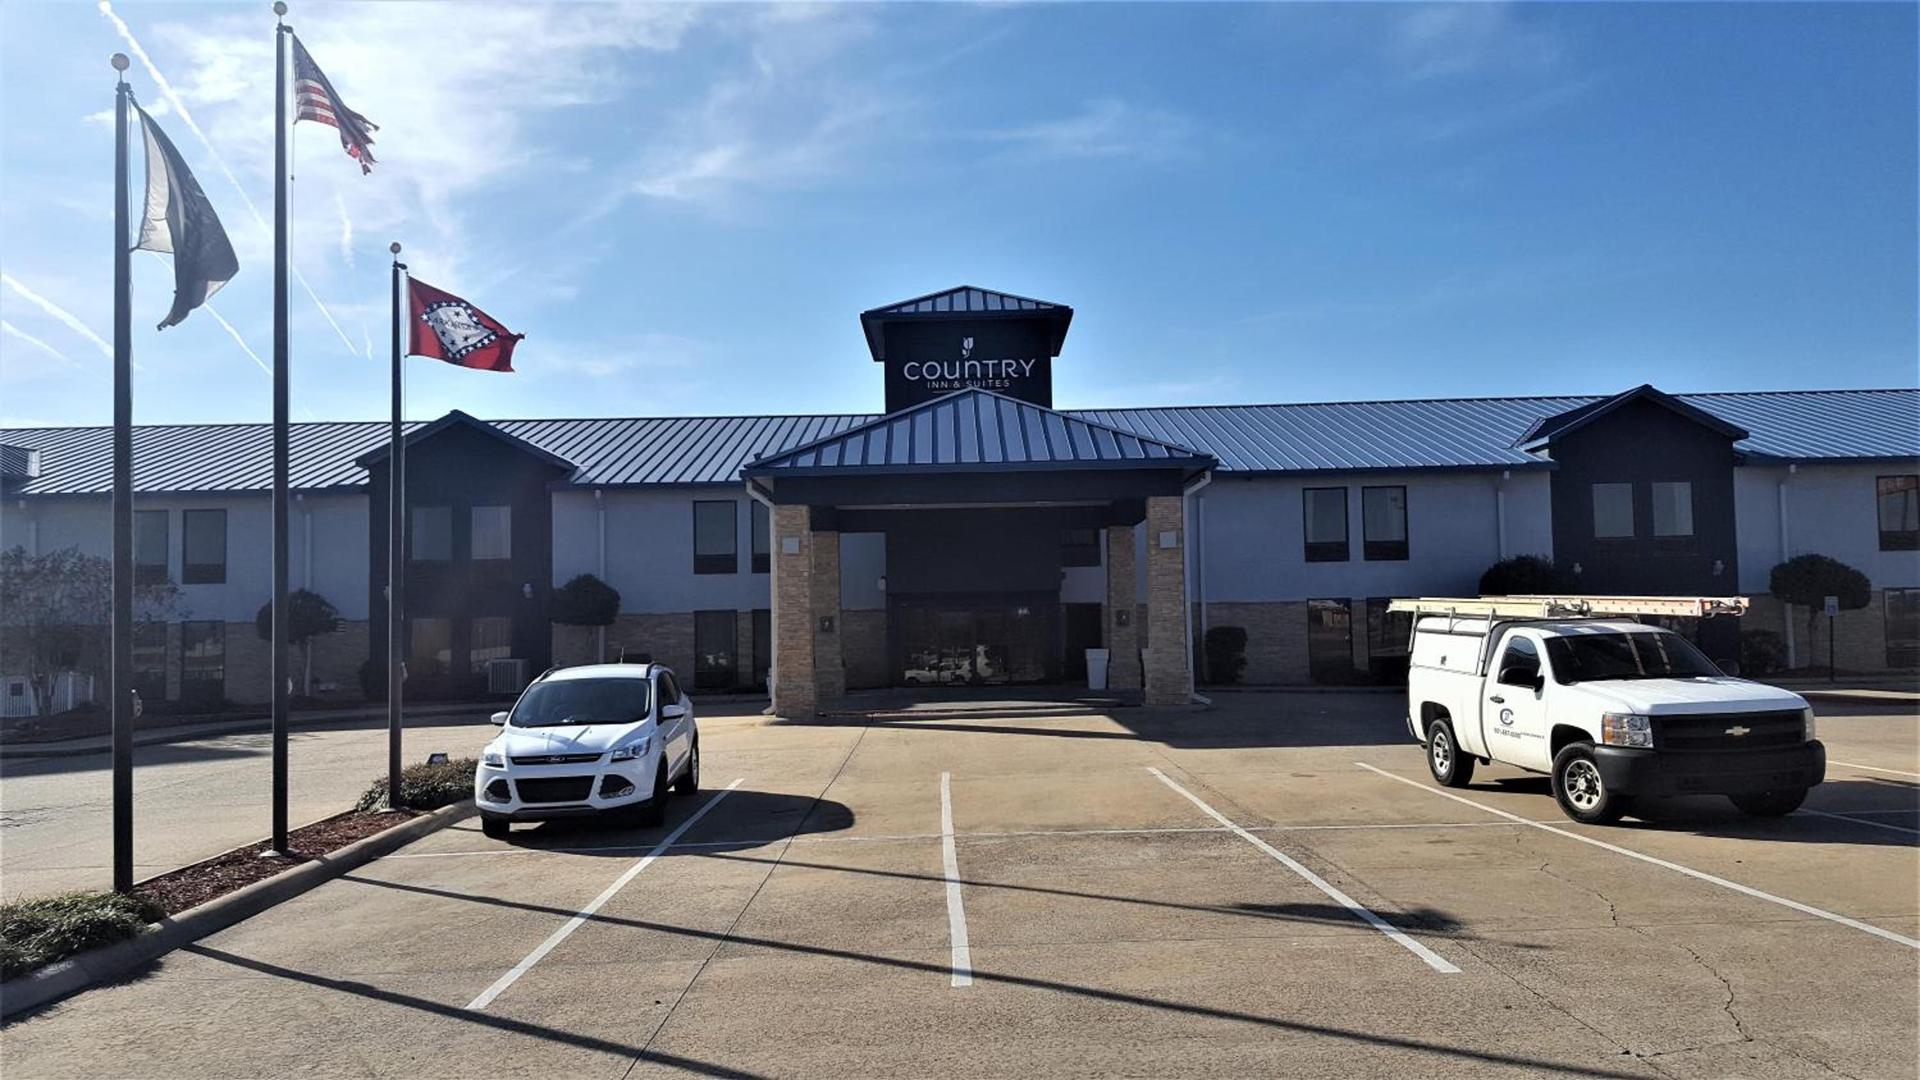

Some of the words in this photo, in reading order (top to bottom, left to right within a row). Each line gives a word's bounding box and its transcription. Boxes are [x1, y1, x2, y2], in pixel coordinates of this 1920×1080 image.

[927, 381, 948, 389] INN
[953, 380, 960, 388] &
[966, 379, 1010, 388] SUITES
